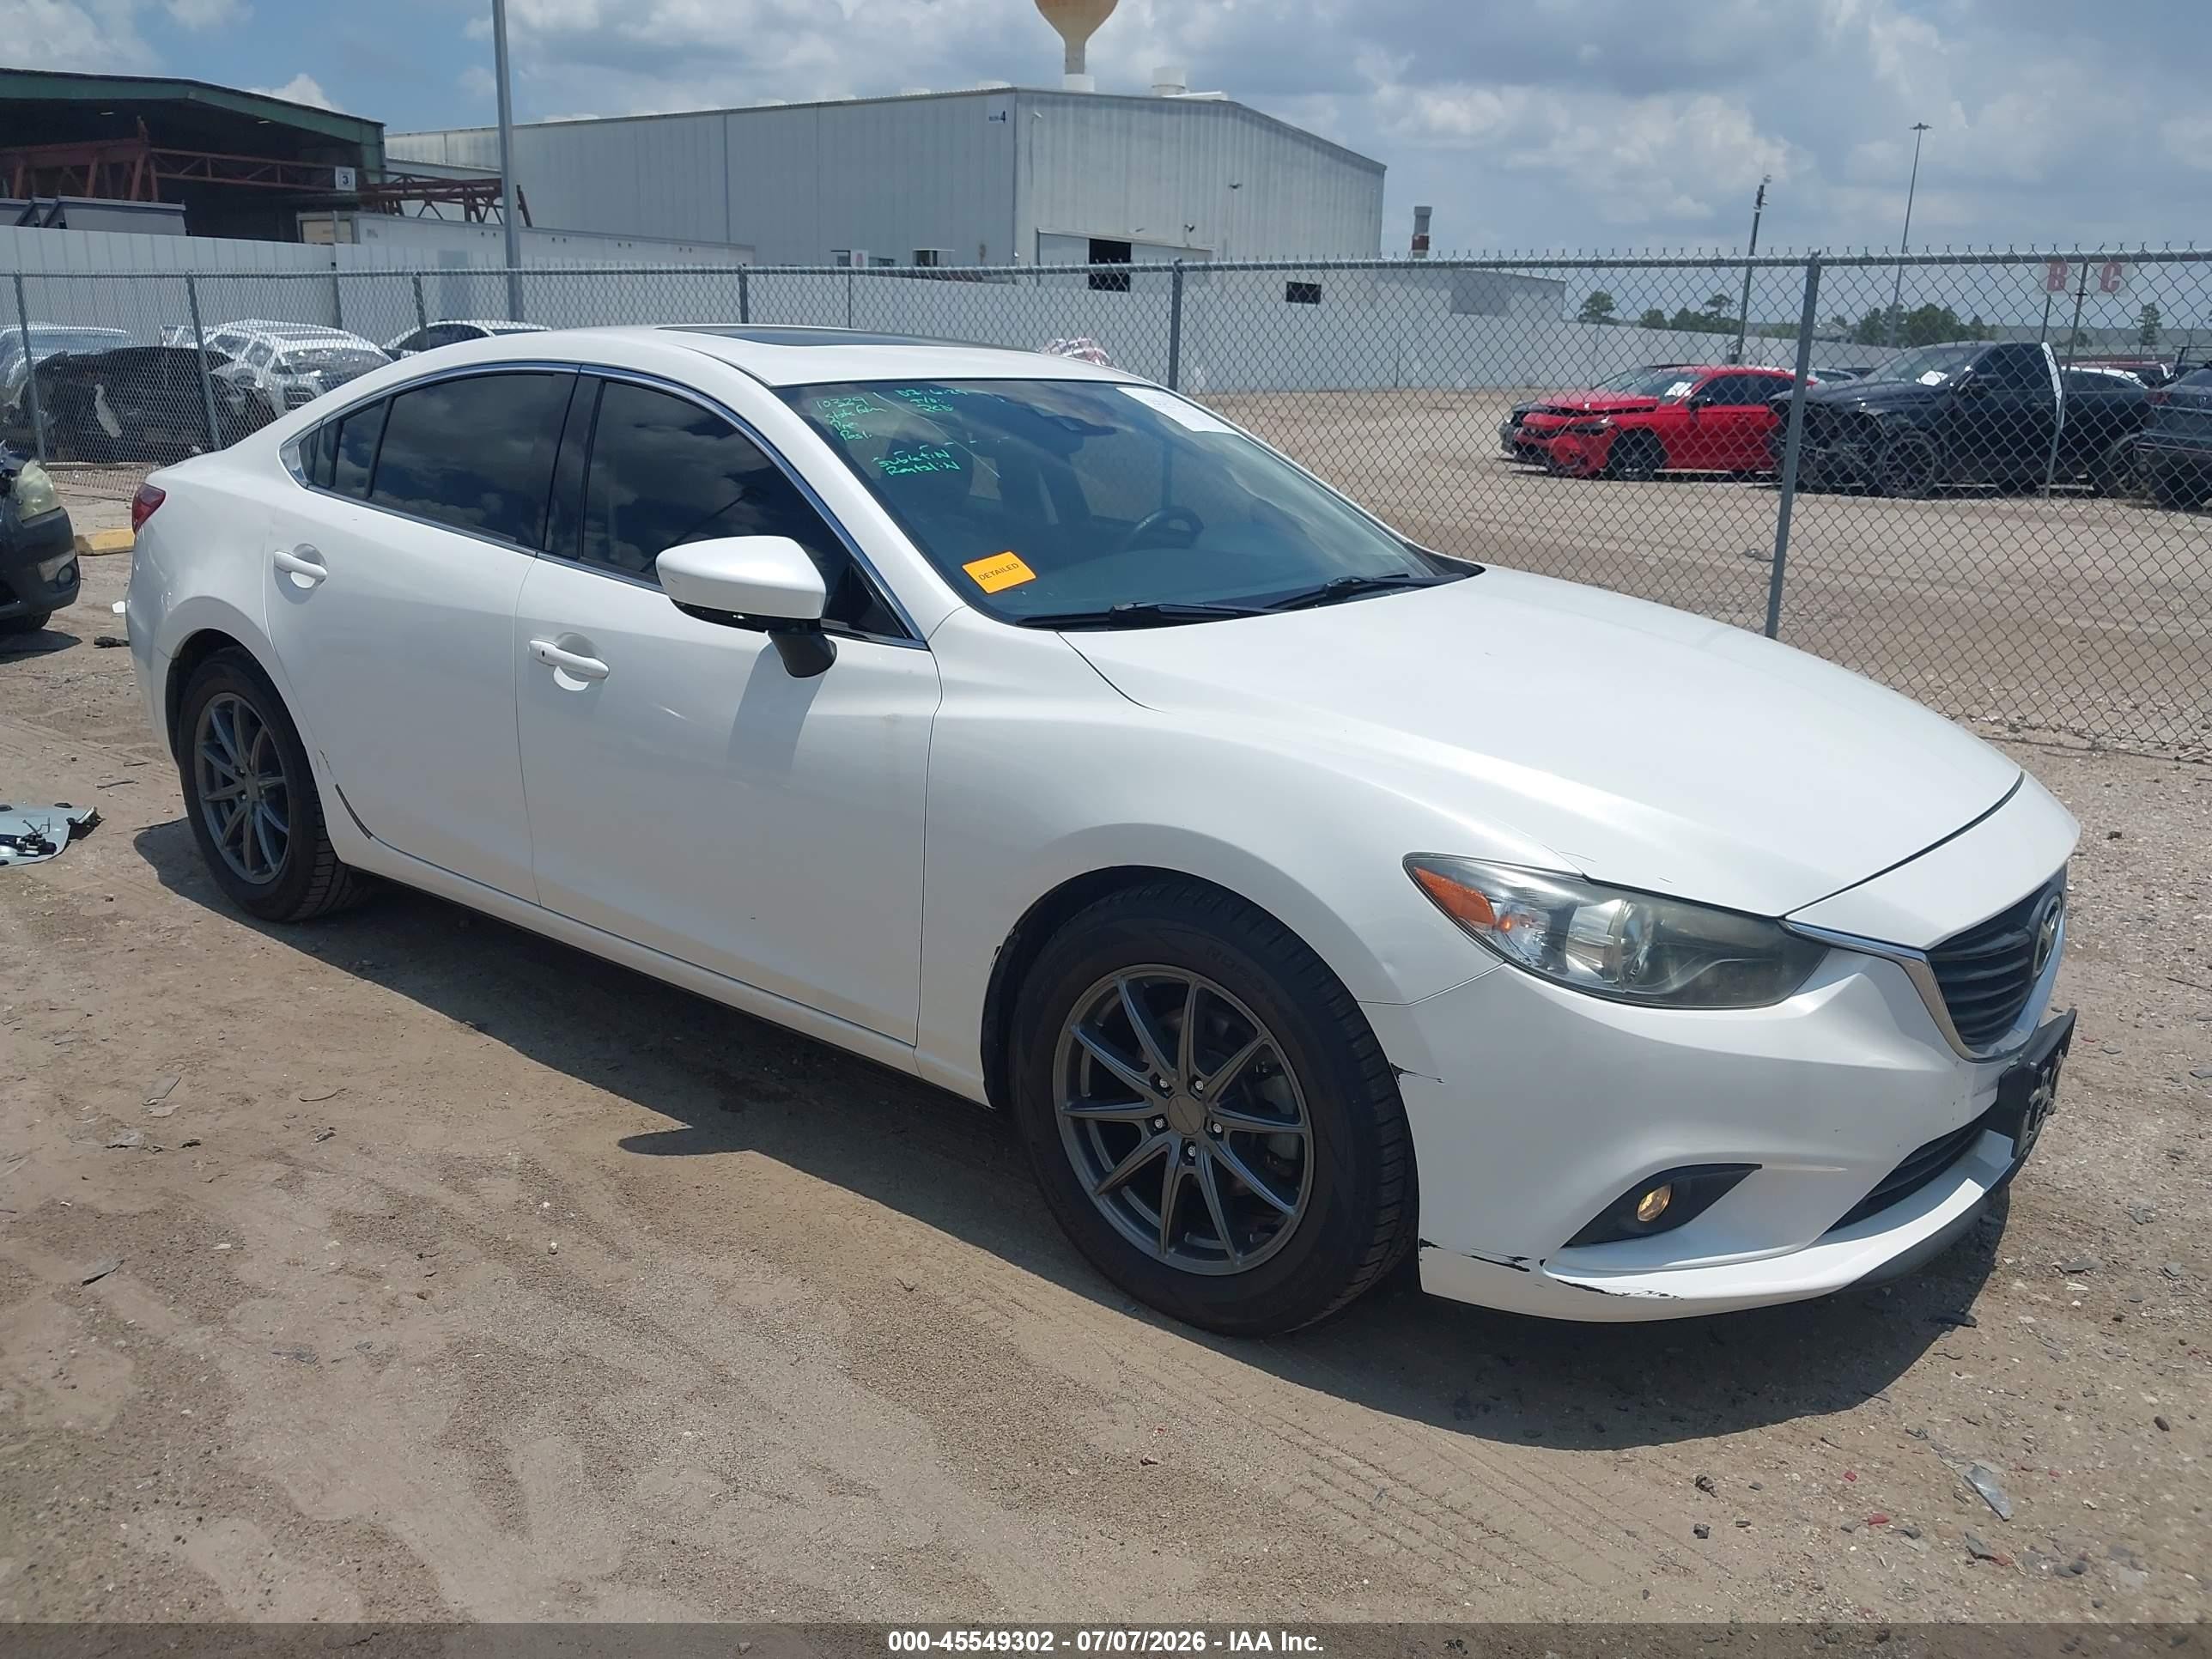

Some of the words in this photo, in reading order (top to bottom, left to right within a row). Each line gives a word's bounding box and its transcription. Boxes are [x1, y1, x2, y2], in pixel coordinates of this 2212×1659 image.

[343, 175, 349, 185] 3
[2047, 260, 2068, 291] B
[2100, 261, 2122, 293] C
[978, 562, 1019, 580] DETAILED
